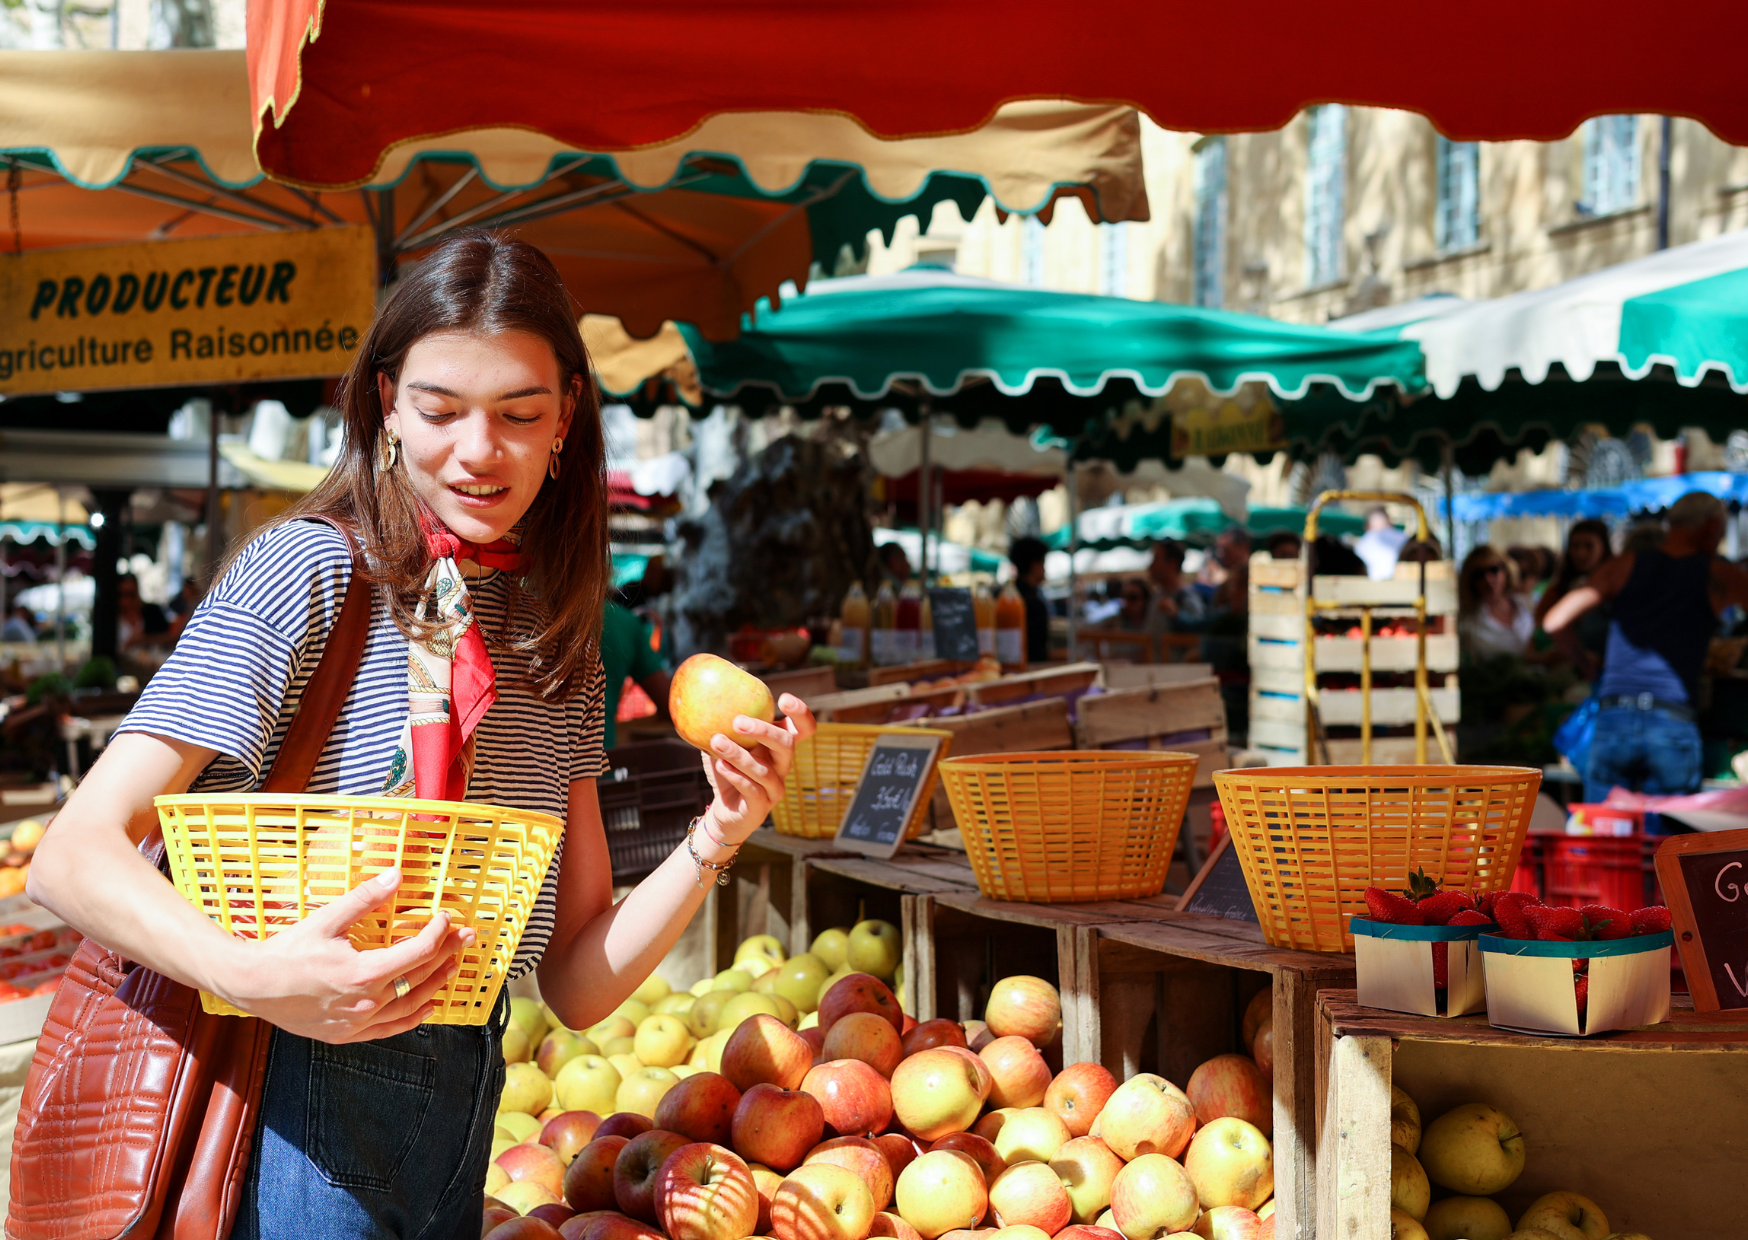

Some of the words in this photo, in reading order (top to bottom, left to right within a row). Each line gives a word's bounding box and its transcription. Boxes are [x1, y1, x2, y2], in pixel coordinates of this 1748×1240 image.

[30, 260, 297, 322] PRODUCTEUR
[0, 335, 155, 381] griculture
[170, 319, 358, 361] Raisonnée
